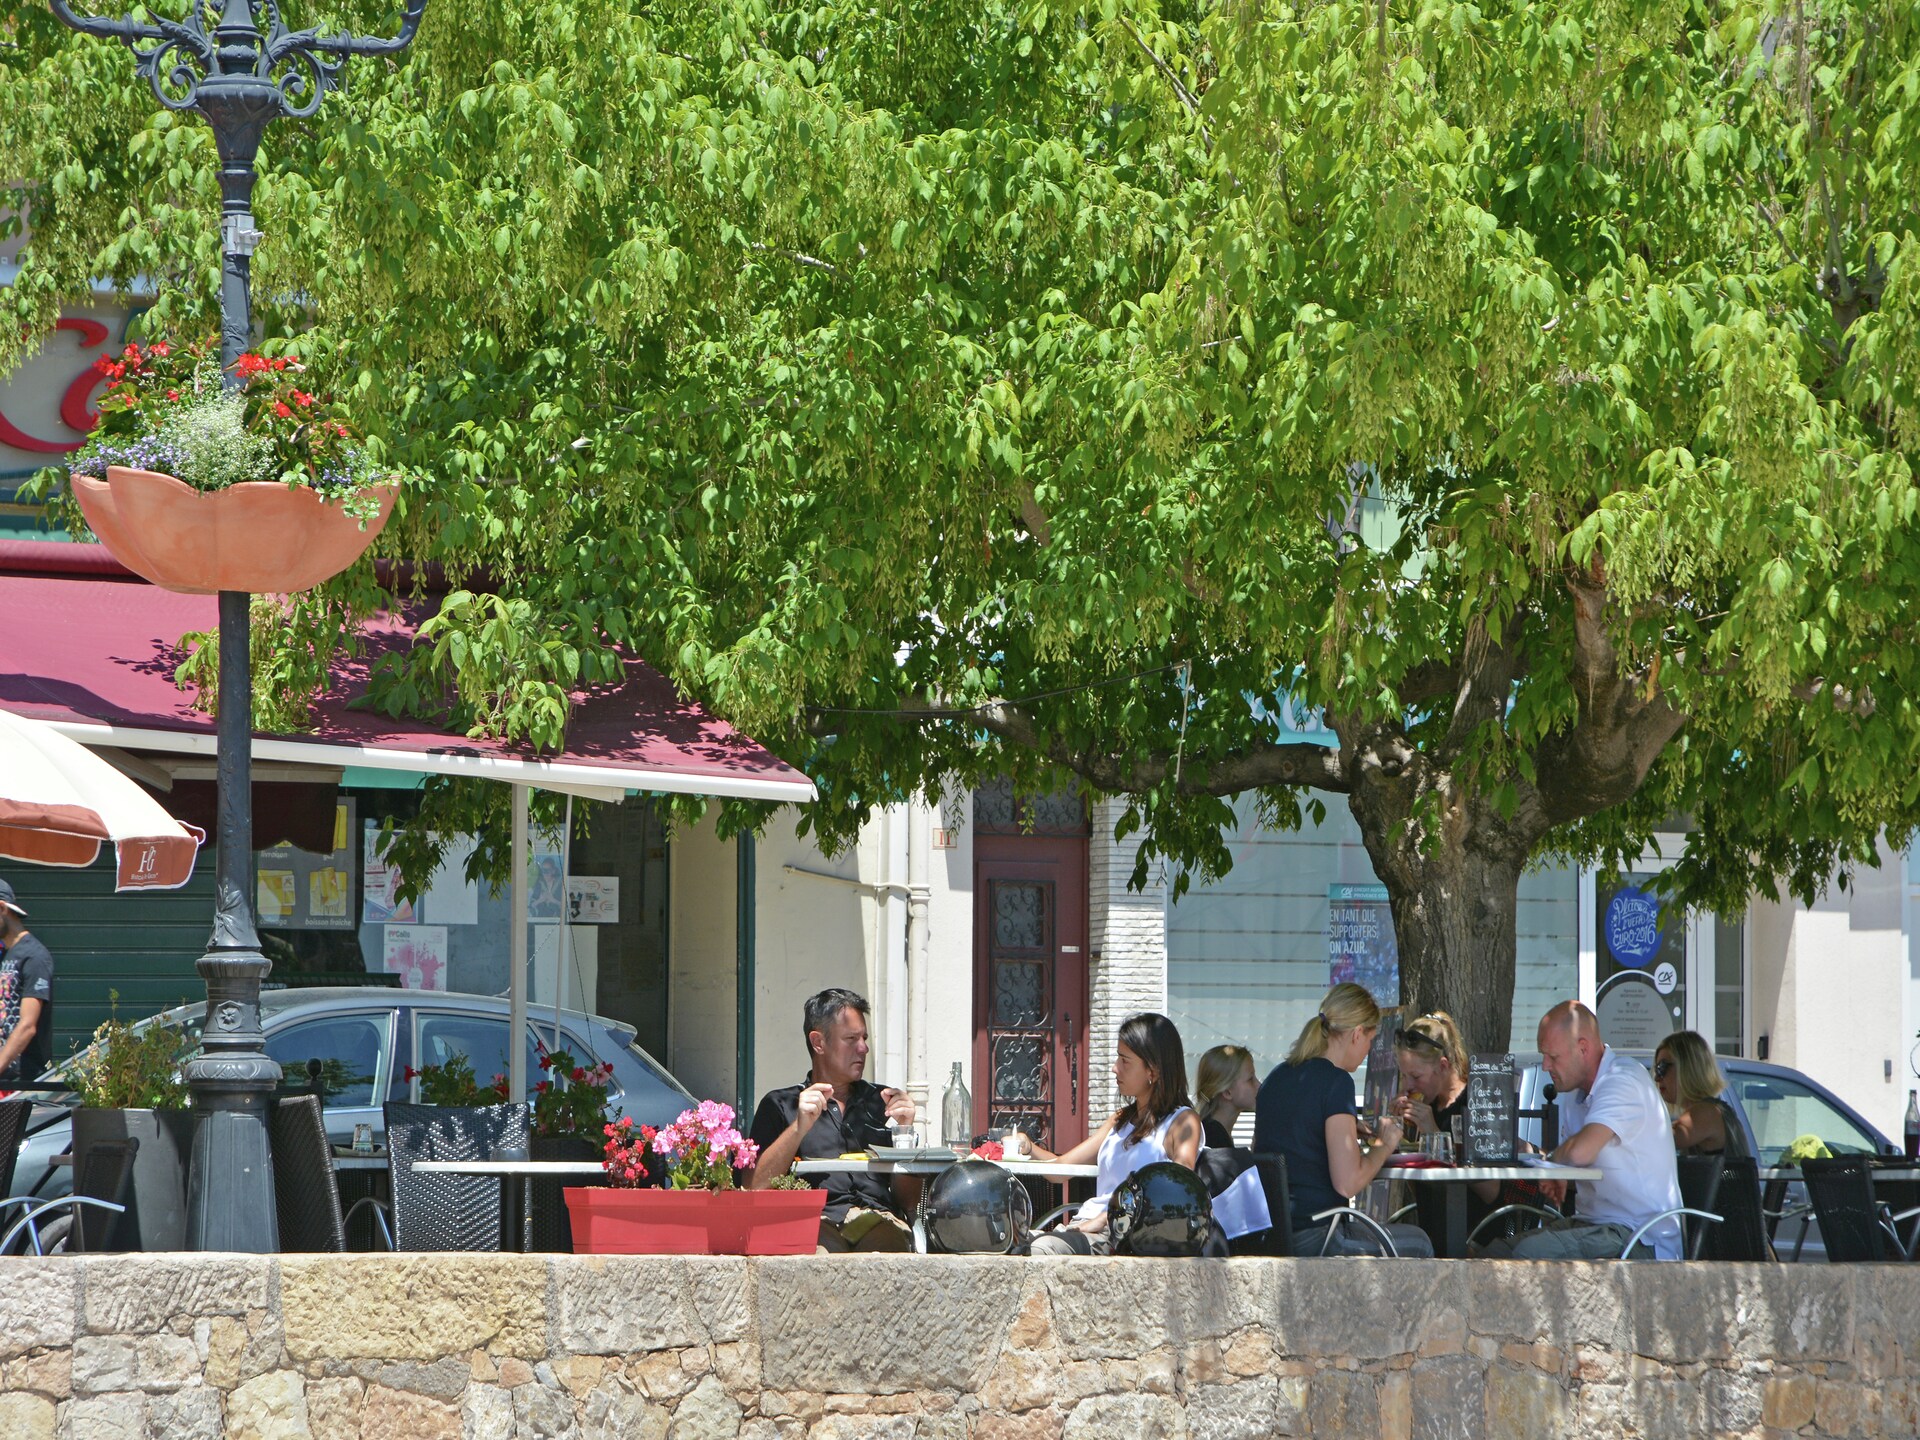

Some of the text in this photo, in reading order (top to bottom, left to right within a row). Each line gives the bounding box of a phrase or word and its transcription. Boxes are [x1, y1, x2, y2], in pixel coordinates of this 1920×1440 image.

[1330, 909, 1376, 922] EN TANT QUE
[305, 918, 329, 926] boisson
[1330, 925, 1379, 939] SUPPORTERS,
[1330, 941, 1368, 953] ON AZUR.
